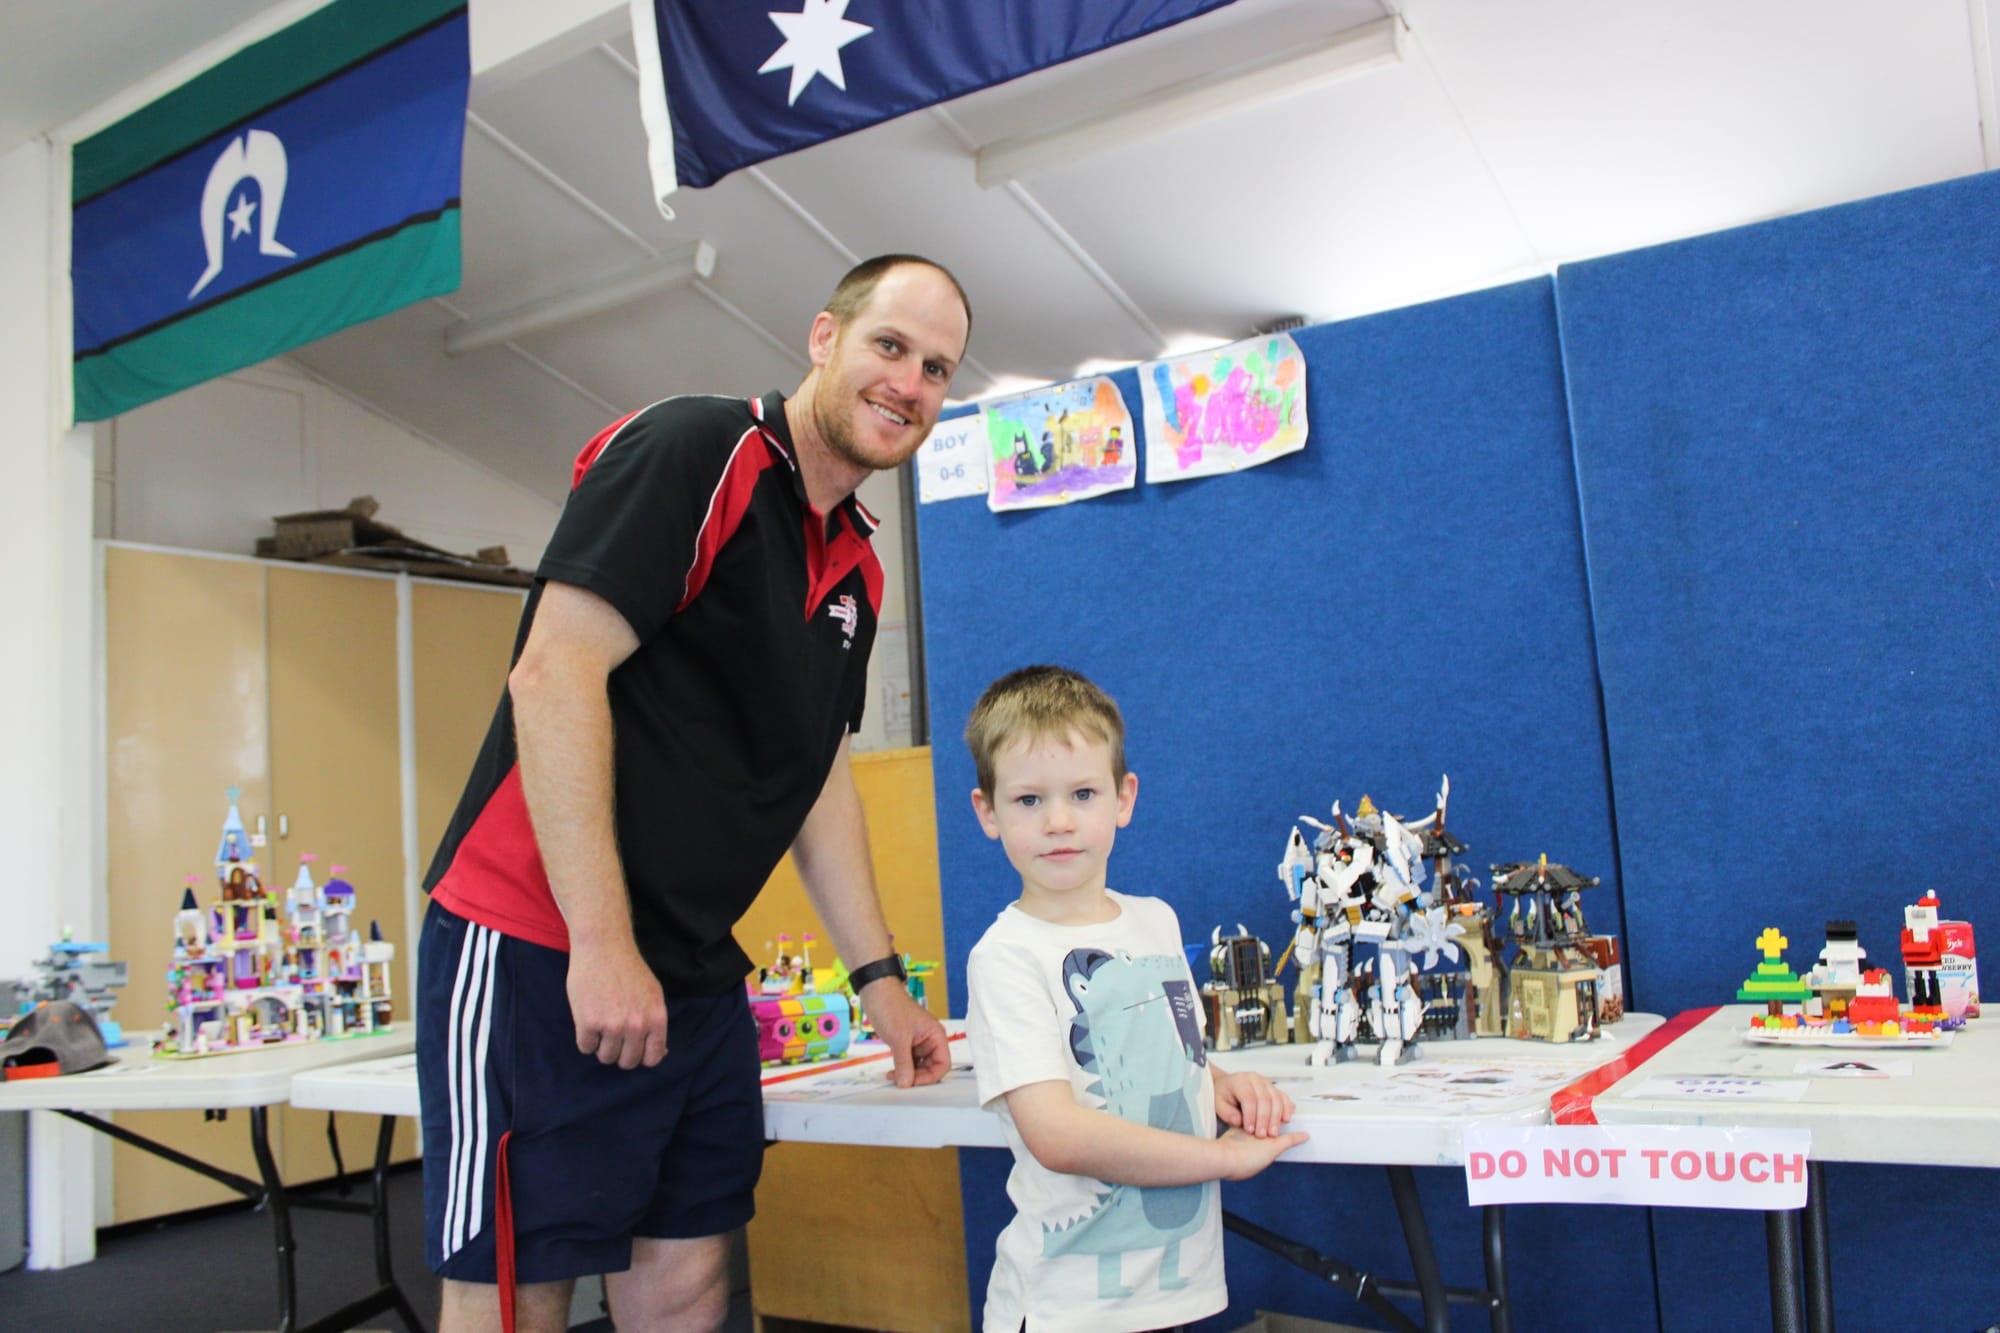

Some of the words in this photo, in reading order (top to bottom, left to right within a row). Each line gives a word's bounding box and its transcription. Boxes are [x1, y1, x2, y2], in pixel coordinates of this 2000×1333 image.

[933, 432, 968, 452] BOY
[940, 463, 965, 481] 0-6
[1469, 1150, 1527, 1180] DO
[1543, 1148, 1627, 1179] NOT
[1641, 1150, 1804, 1184] TOUCH
